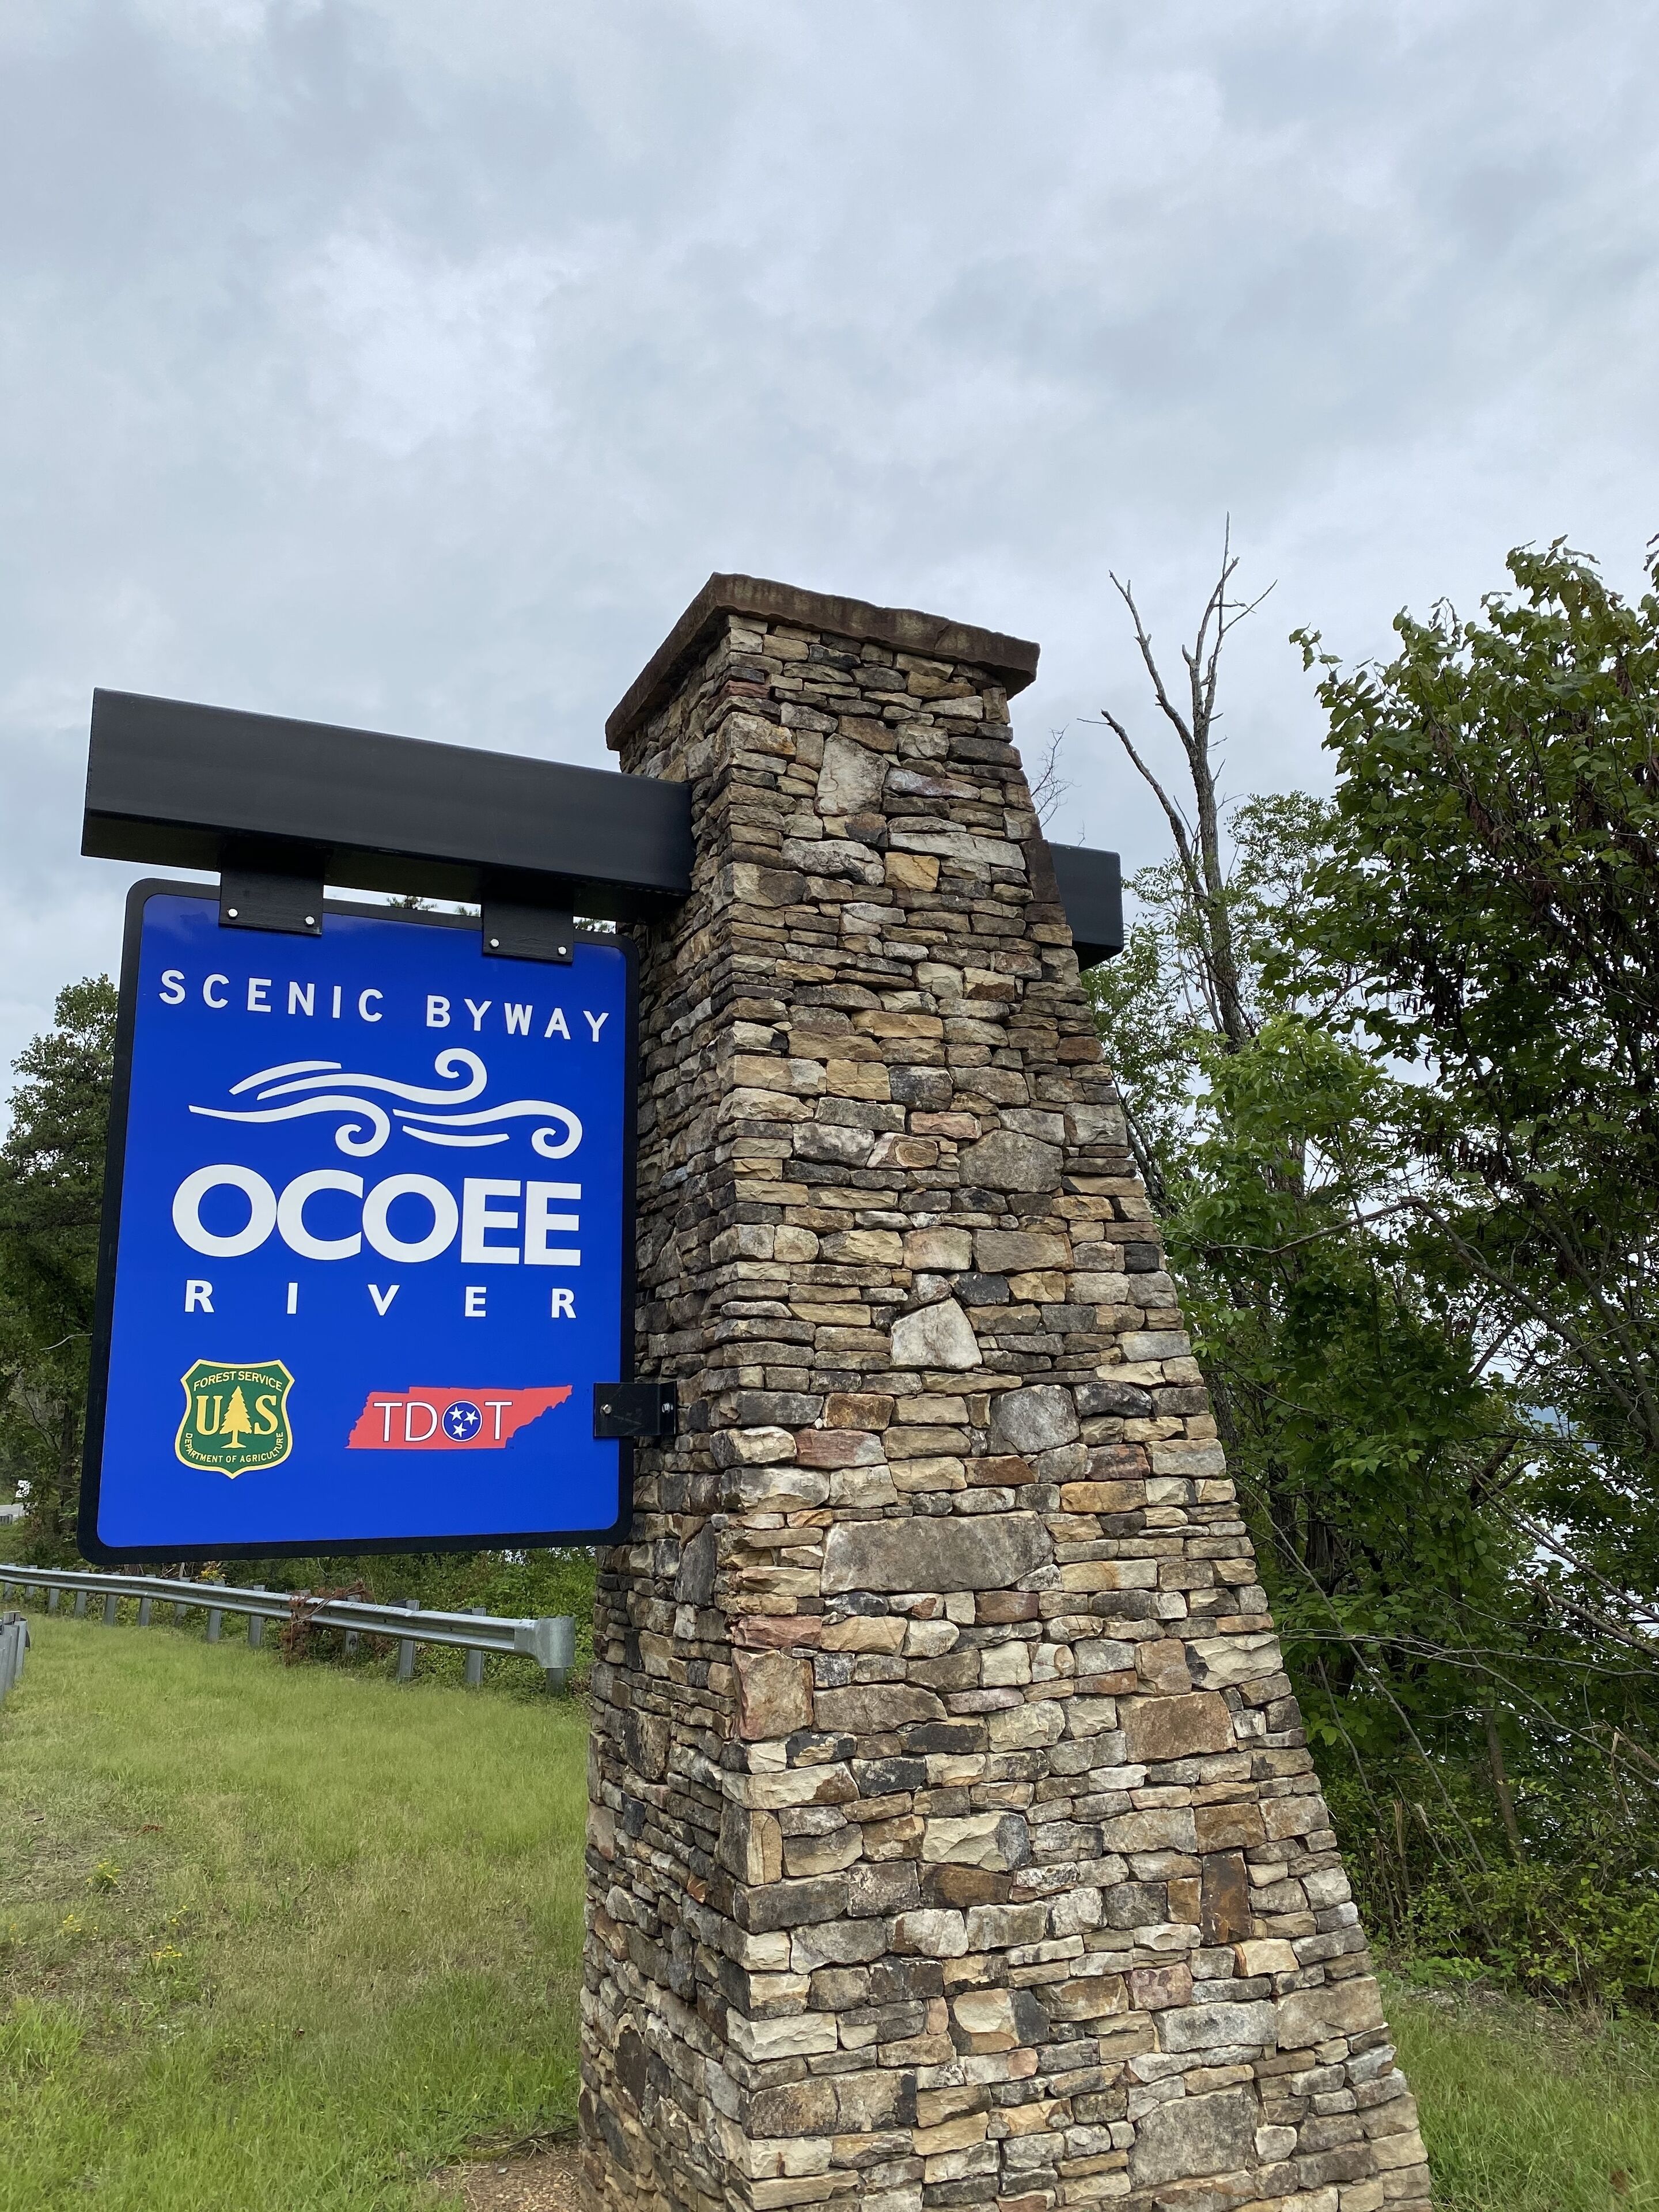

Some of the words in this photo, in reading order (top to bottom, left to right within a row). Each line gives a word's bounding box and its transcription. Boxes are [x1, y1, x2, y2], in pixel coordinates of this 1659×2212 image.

[159, 969, 384, 1022] SCENIC
[426, 995, 609, 1042] BYWAY
[172, 1164, 582, 1266] OCOEE
[184, 1279, 577, 1319] RIVER
[193, 1371, 237, 1392] FOREST
[238, 1370, 283, 1392] SERVICE
[373, 1400, 513, 1442] TDOT
[184, 1432, 224, 1463] DEPARTMENT
[225, 1455, 237, 1463] OF
[239, 1431, 284, 1463] AGRICULTURE
